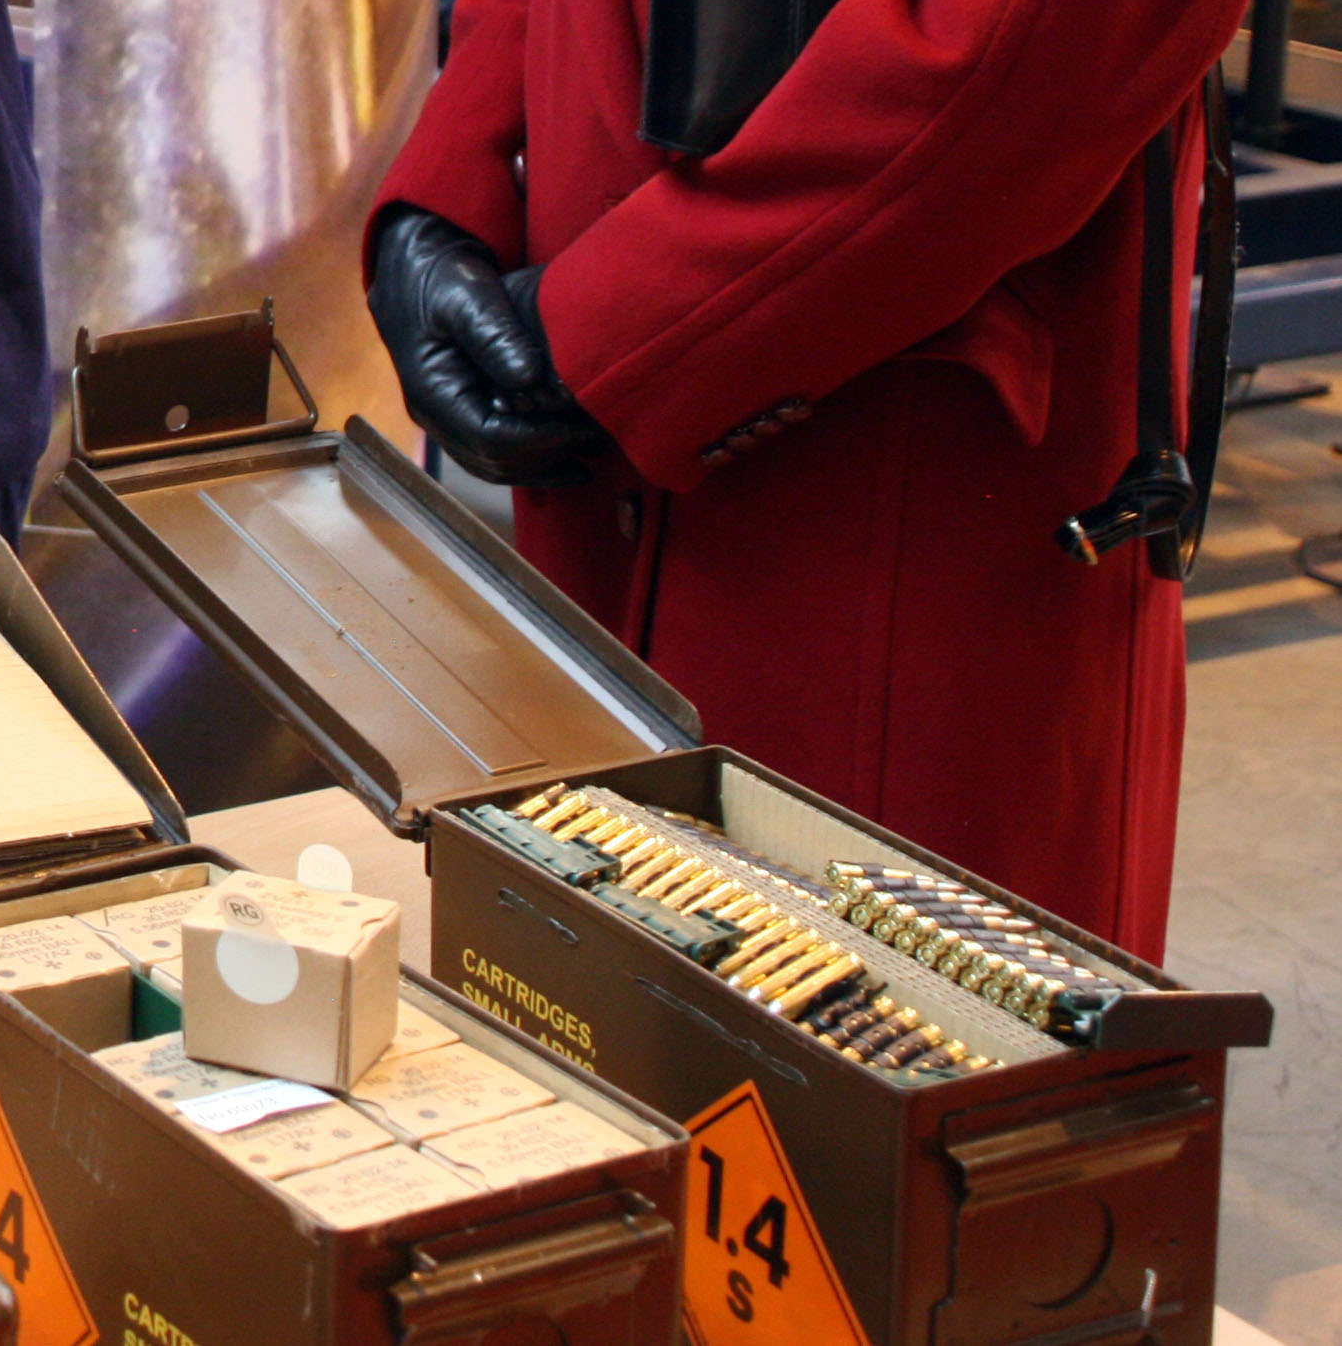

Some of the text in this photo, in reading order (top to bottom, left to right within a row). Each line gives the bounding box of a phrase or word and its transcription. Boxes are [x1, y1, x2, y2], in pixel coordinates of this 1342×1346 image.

[230, 901, 259, 920] RG
[462, 948, 597, 1058] CARTRIDGES,
[700, 1143, 791, 1291] 1.4
[727, 1268, 754, 1323] S
